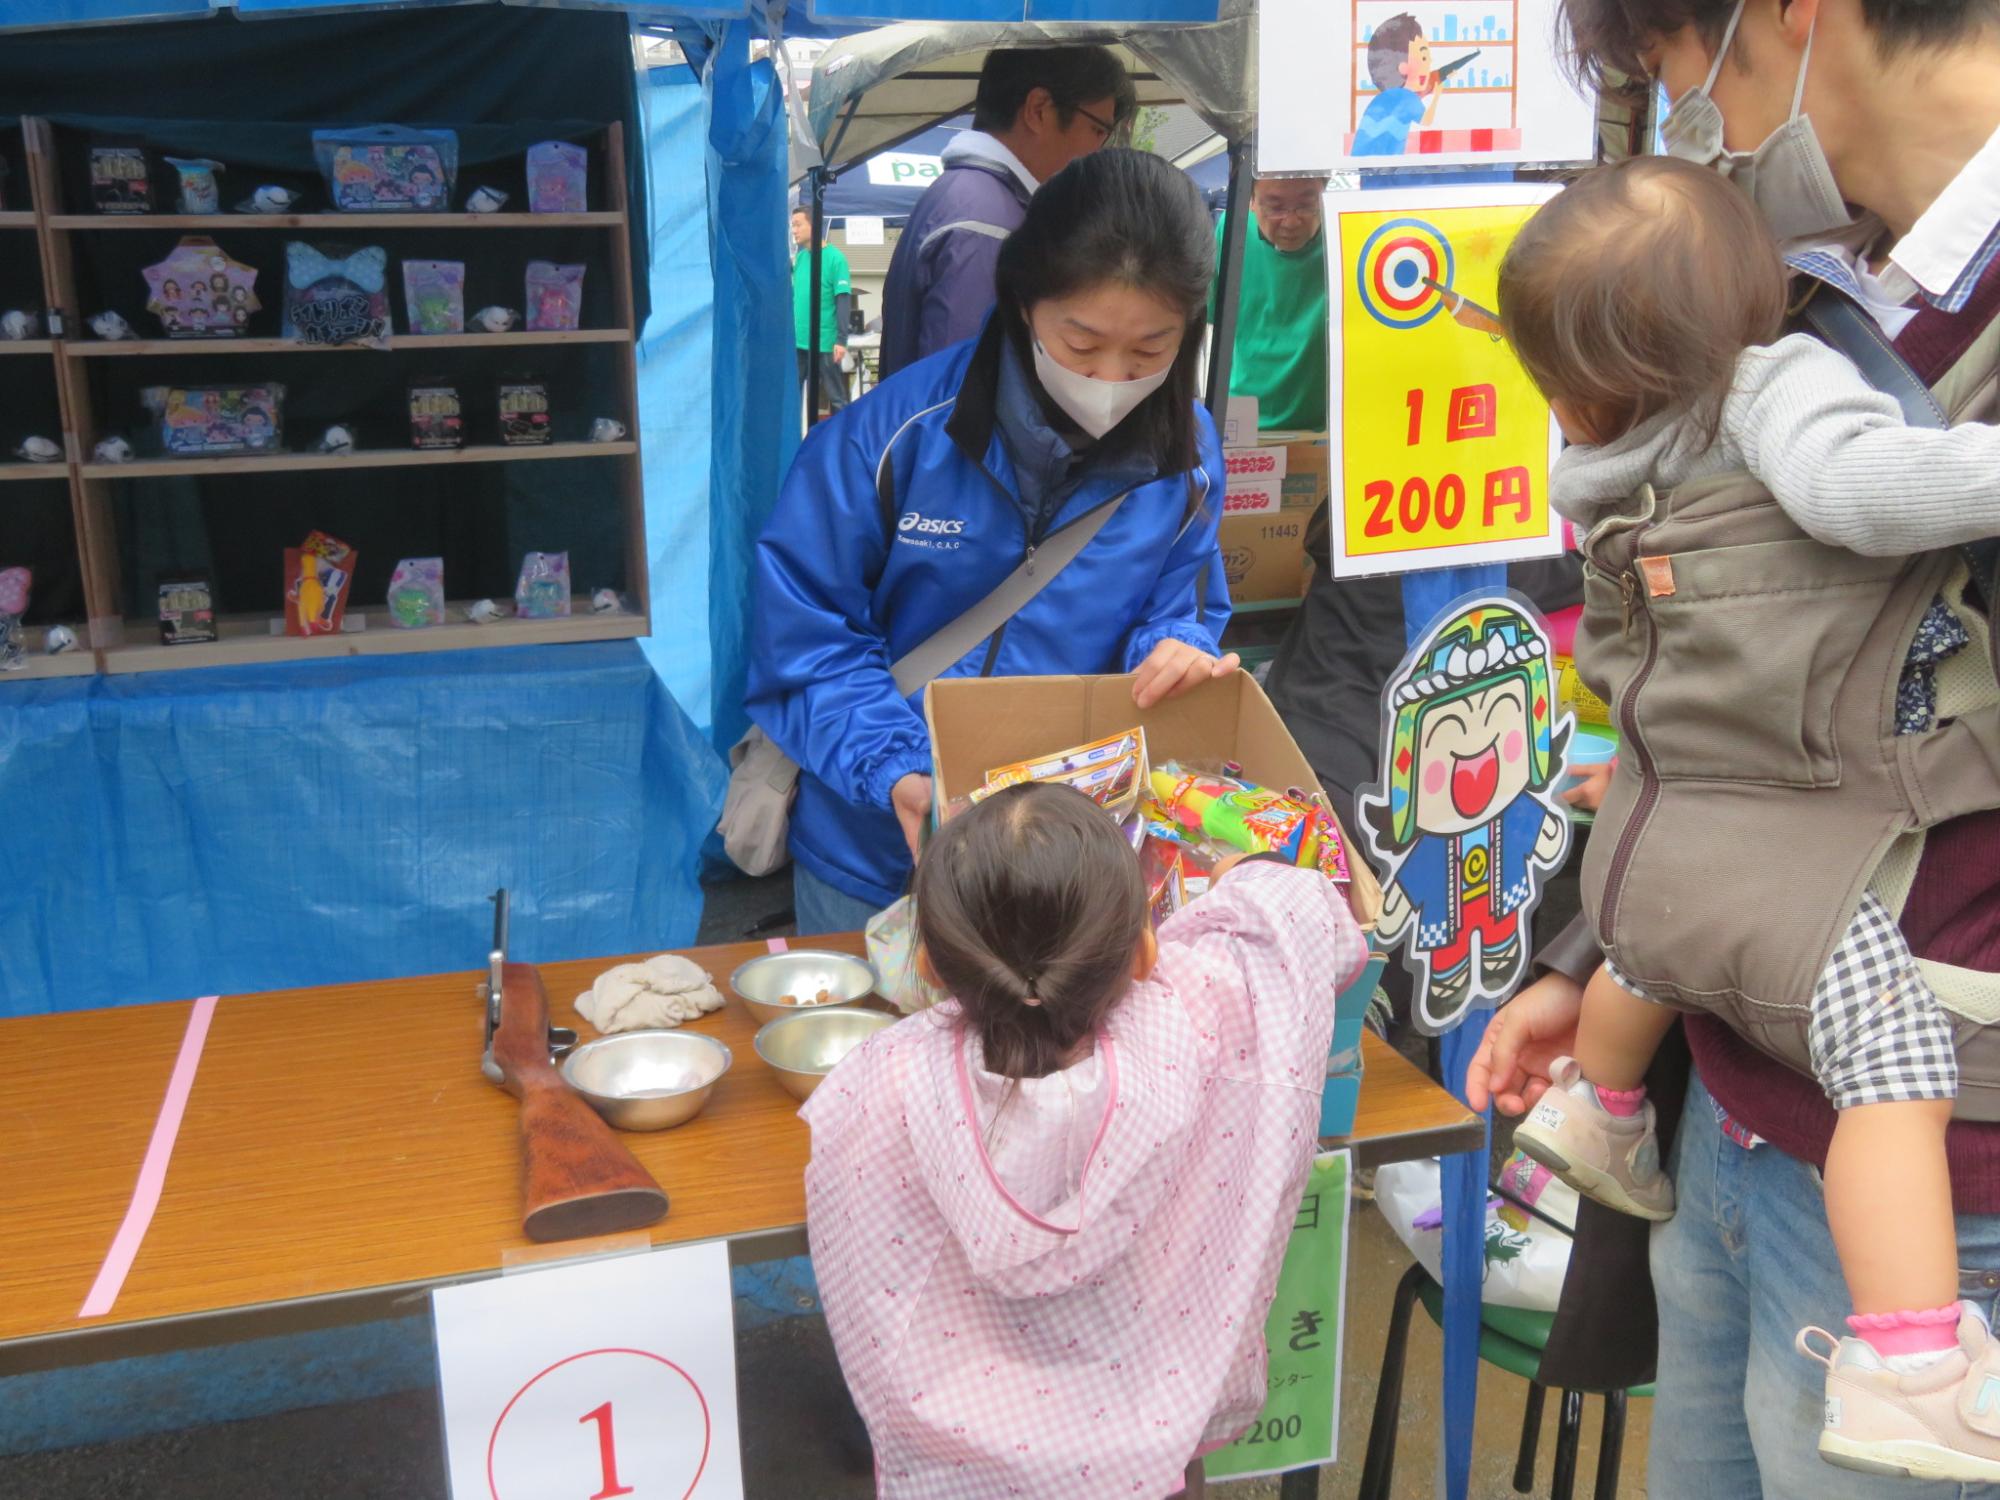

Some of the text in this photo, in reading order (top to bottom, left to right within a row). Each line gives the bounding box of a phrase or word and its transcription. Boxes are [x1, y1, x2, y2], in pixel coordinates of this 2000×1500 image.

[1364, 465, 1532, 538] 200円
[916, 517, 965, 535] asics
[1261, 524, 1299, 539] 11443
[1289, 1310, 1323, 1351] き
[1267, 1373, 1313, 1391] ンター
